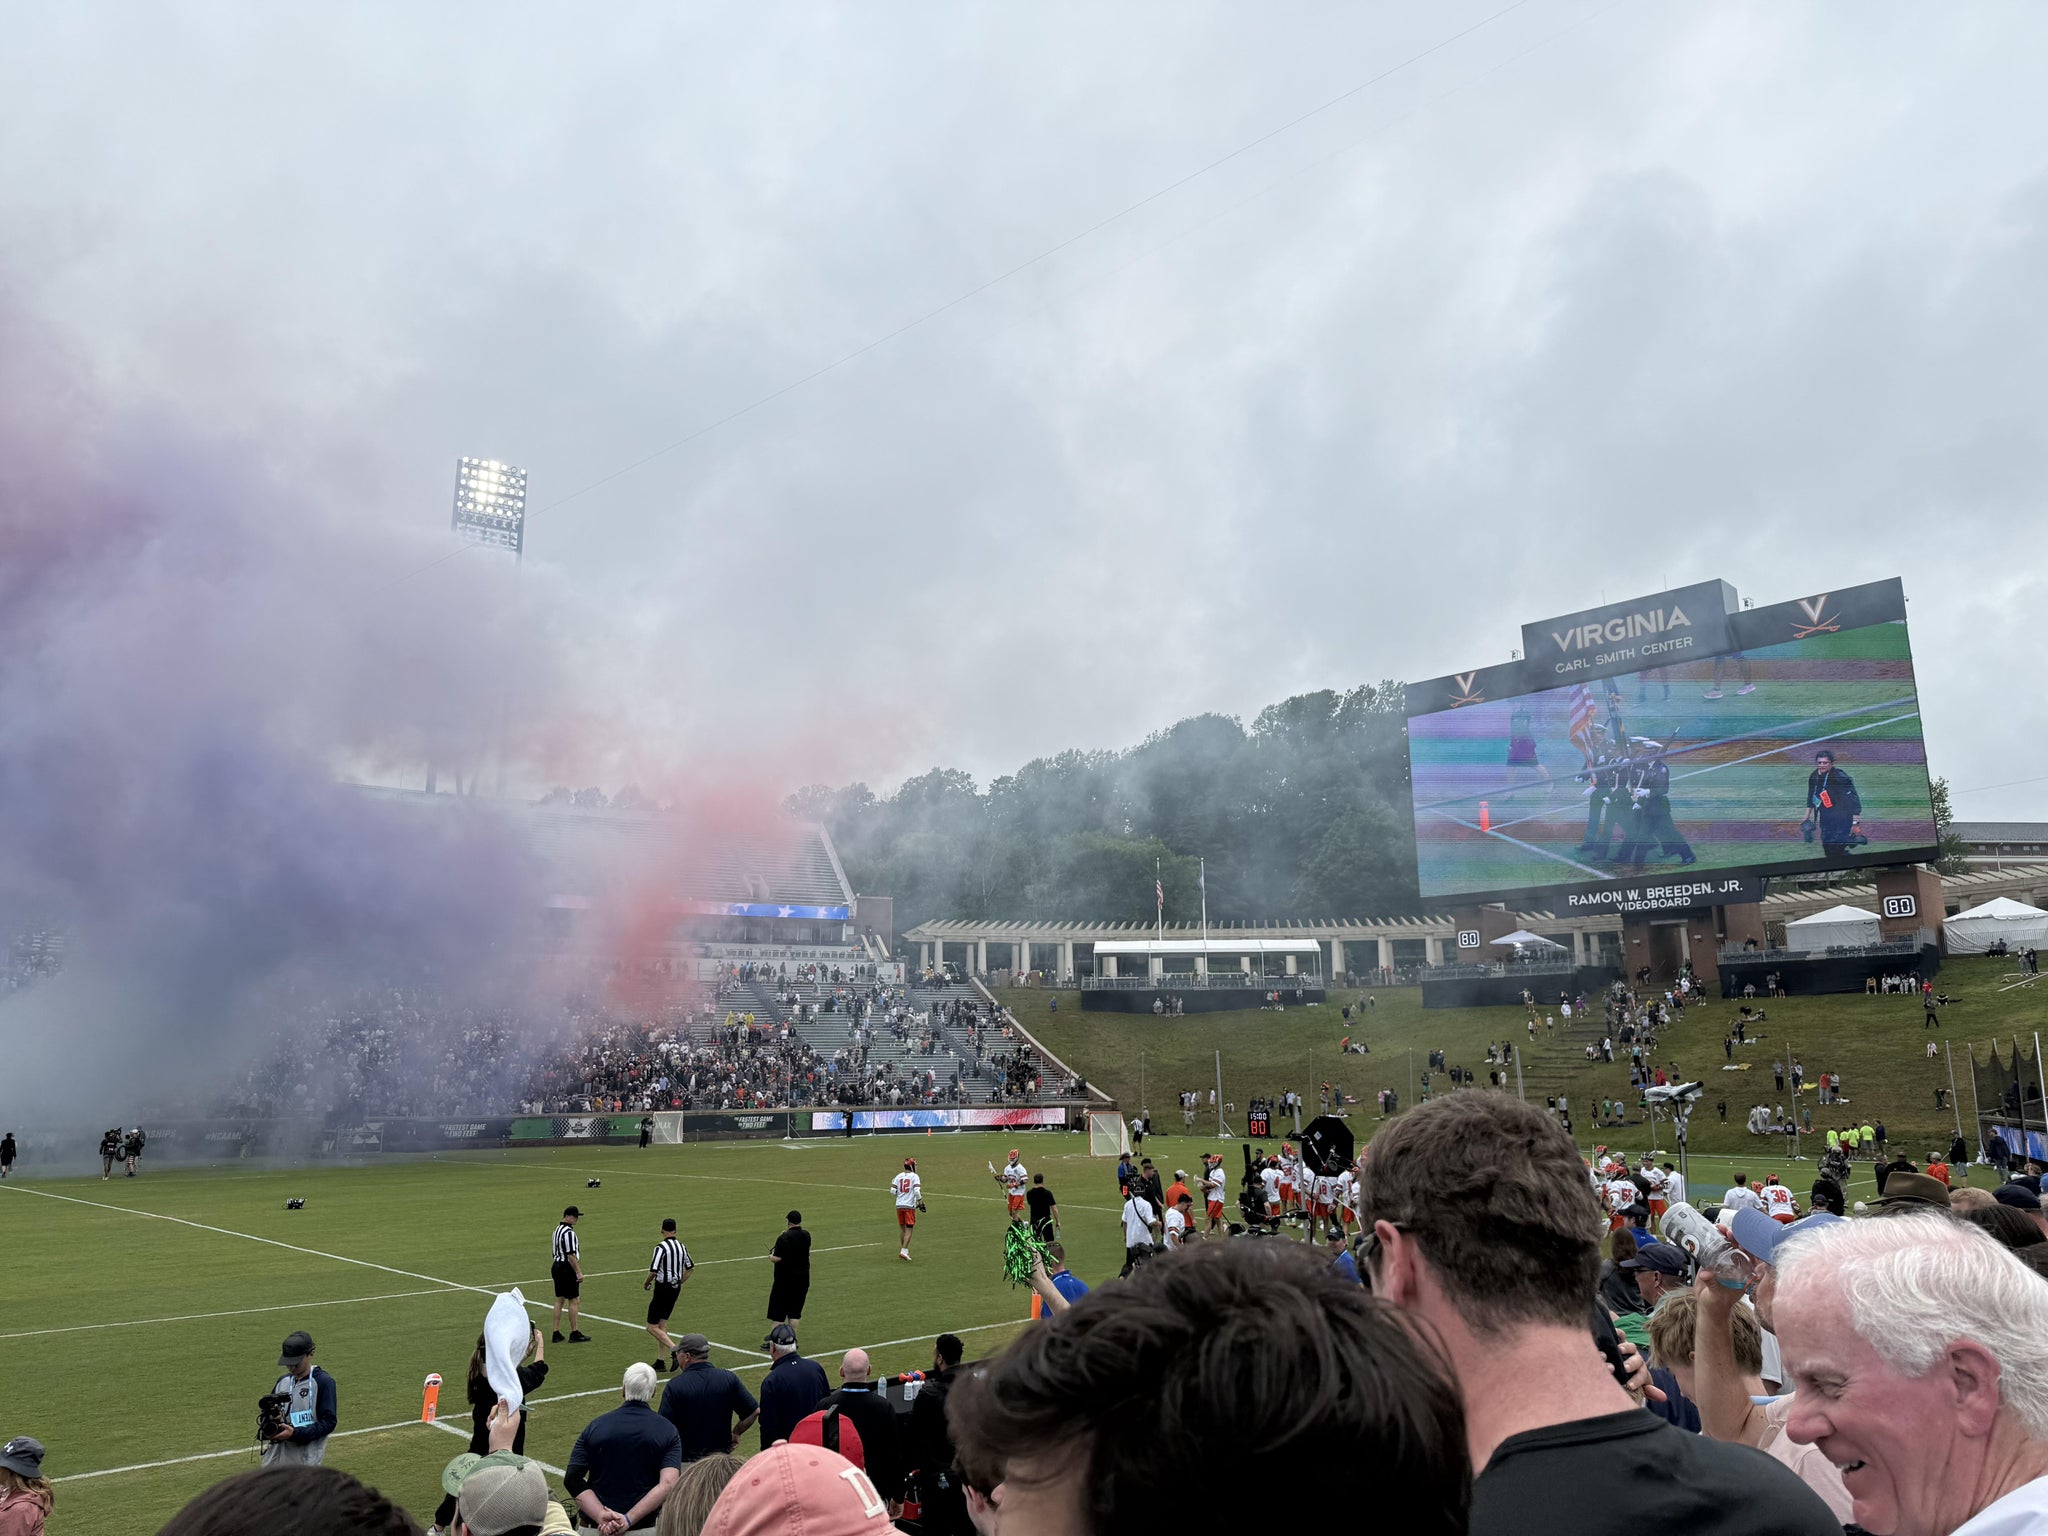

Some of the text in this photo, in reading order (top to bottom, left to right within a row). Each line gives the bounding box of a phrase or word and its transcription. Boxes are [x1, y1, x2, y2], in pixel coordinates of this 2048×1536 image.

[1552, 605, 1692, 652] VIRGINIA
[1555, 636, 1693, 673] CARL SMITH CENTER
[1568, 890, 1622, 906] RAMON
[1626, 889, 1641, 901] W.
[1718, 879, 1743, 893] JR.
[1616, 897, 1691, 911] VIDEOBOARD
[1889, 899, 1910, 913] 80
[1462, 933, 1476, 945] 80
[1250, 1112, 1267, 1120] 15:00
[1250, 1120, 1266, 1134] 80
[900, 1179, 910, 1193] 12
[1770, 1189, 1788, 1202] 36
[838, 1467, 886, 1519] D
